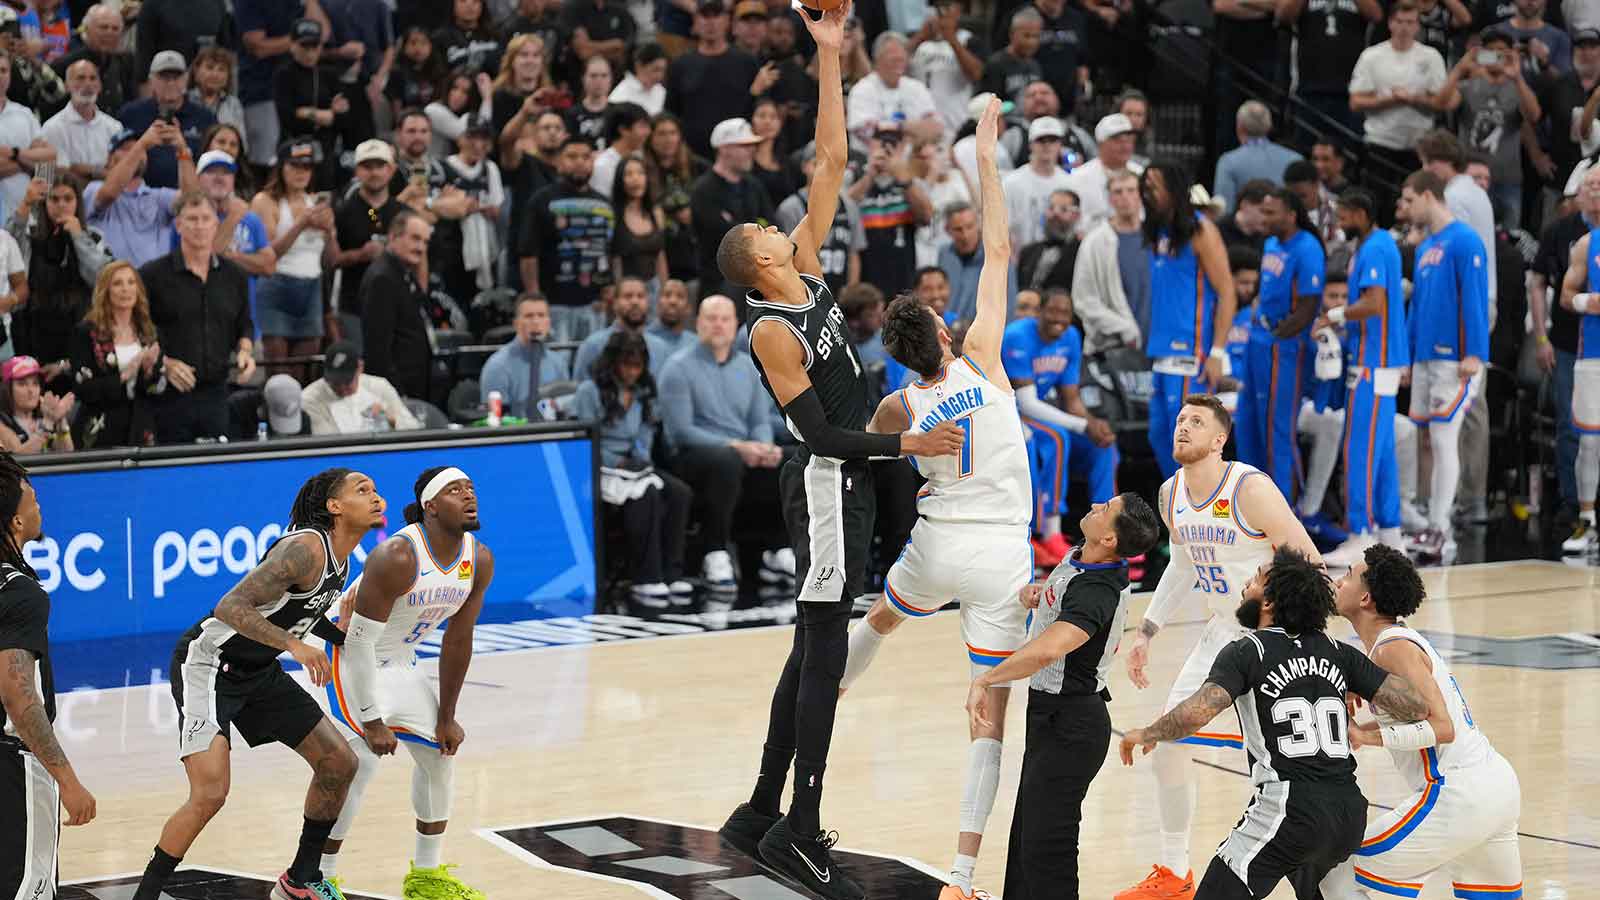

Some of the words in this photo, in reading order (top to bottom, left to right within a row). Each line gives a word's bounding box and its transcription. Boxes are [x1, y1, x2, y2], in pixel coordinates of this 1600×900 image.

[1324, 15, 1337, 36] 1
[955, 412, 974, 479] 1
[403, 620, 432, 643] 5
[1260, 655, 1348, 699] CHAMPAGNIE
[1270, 696, 1351, 759] 30
